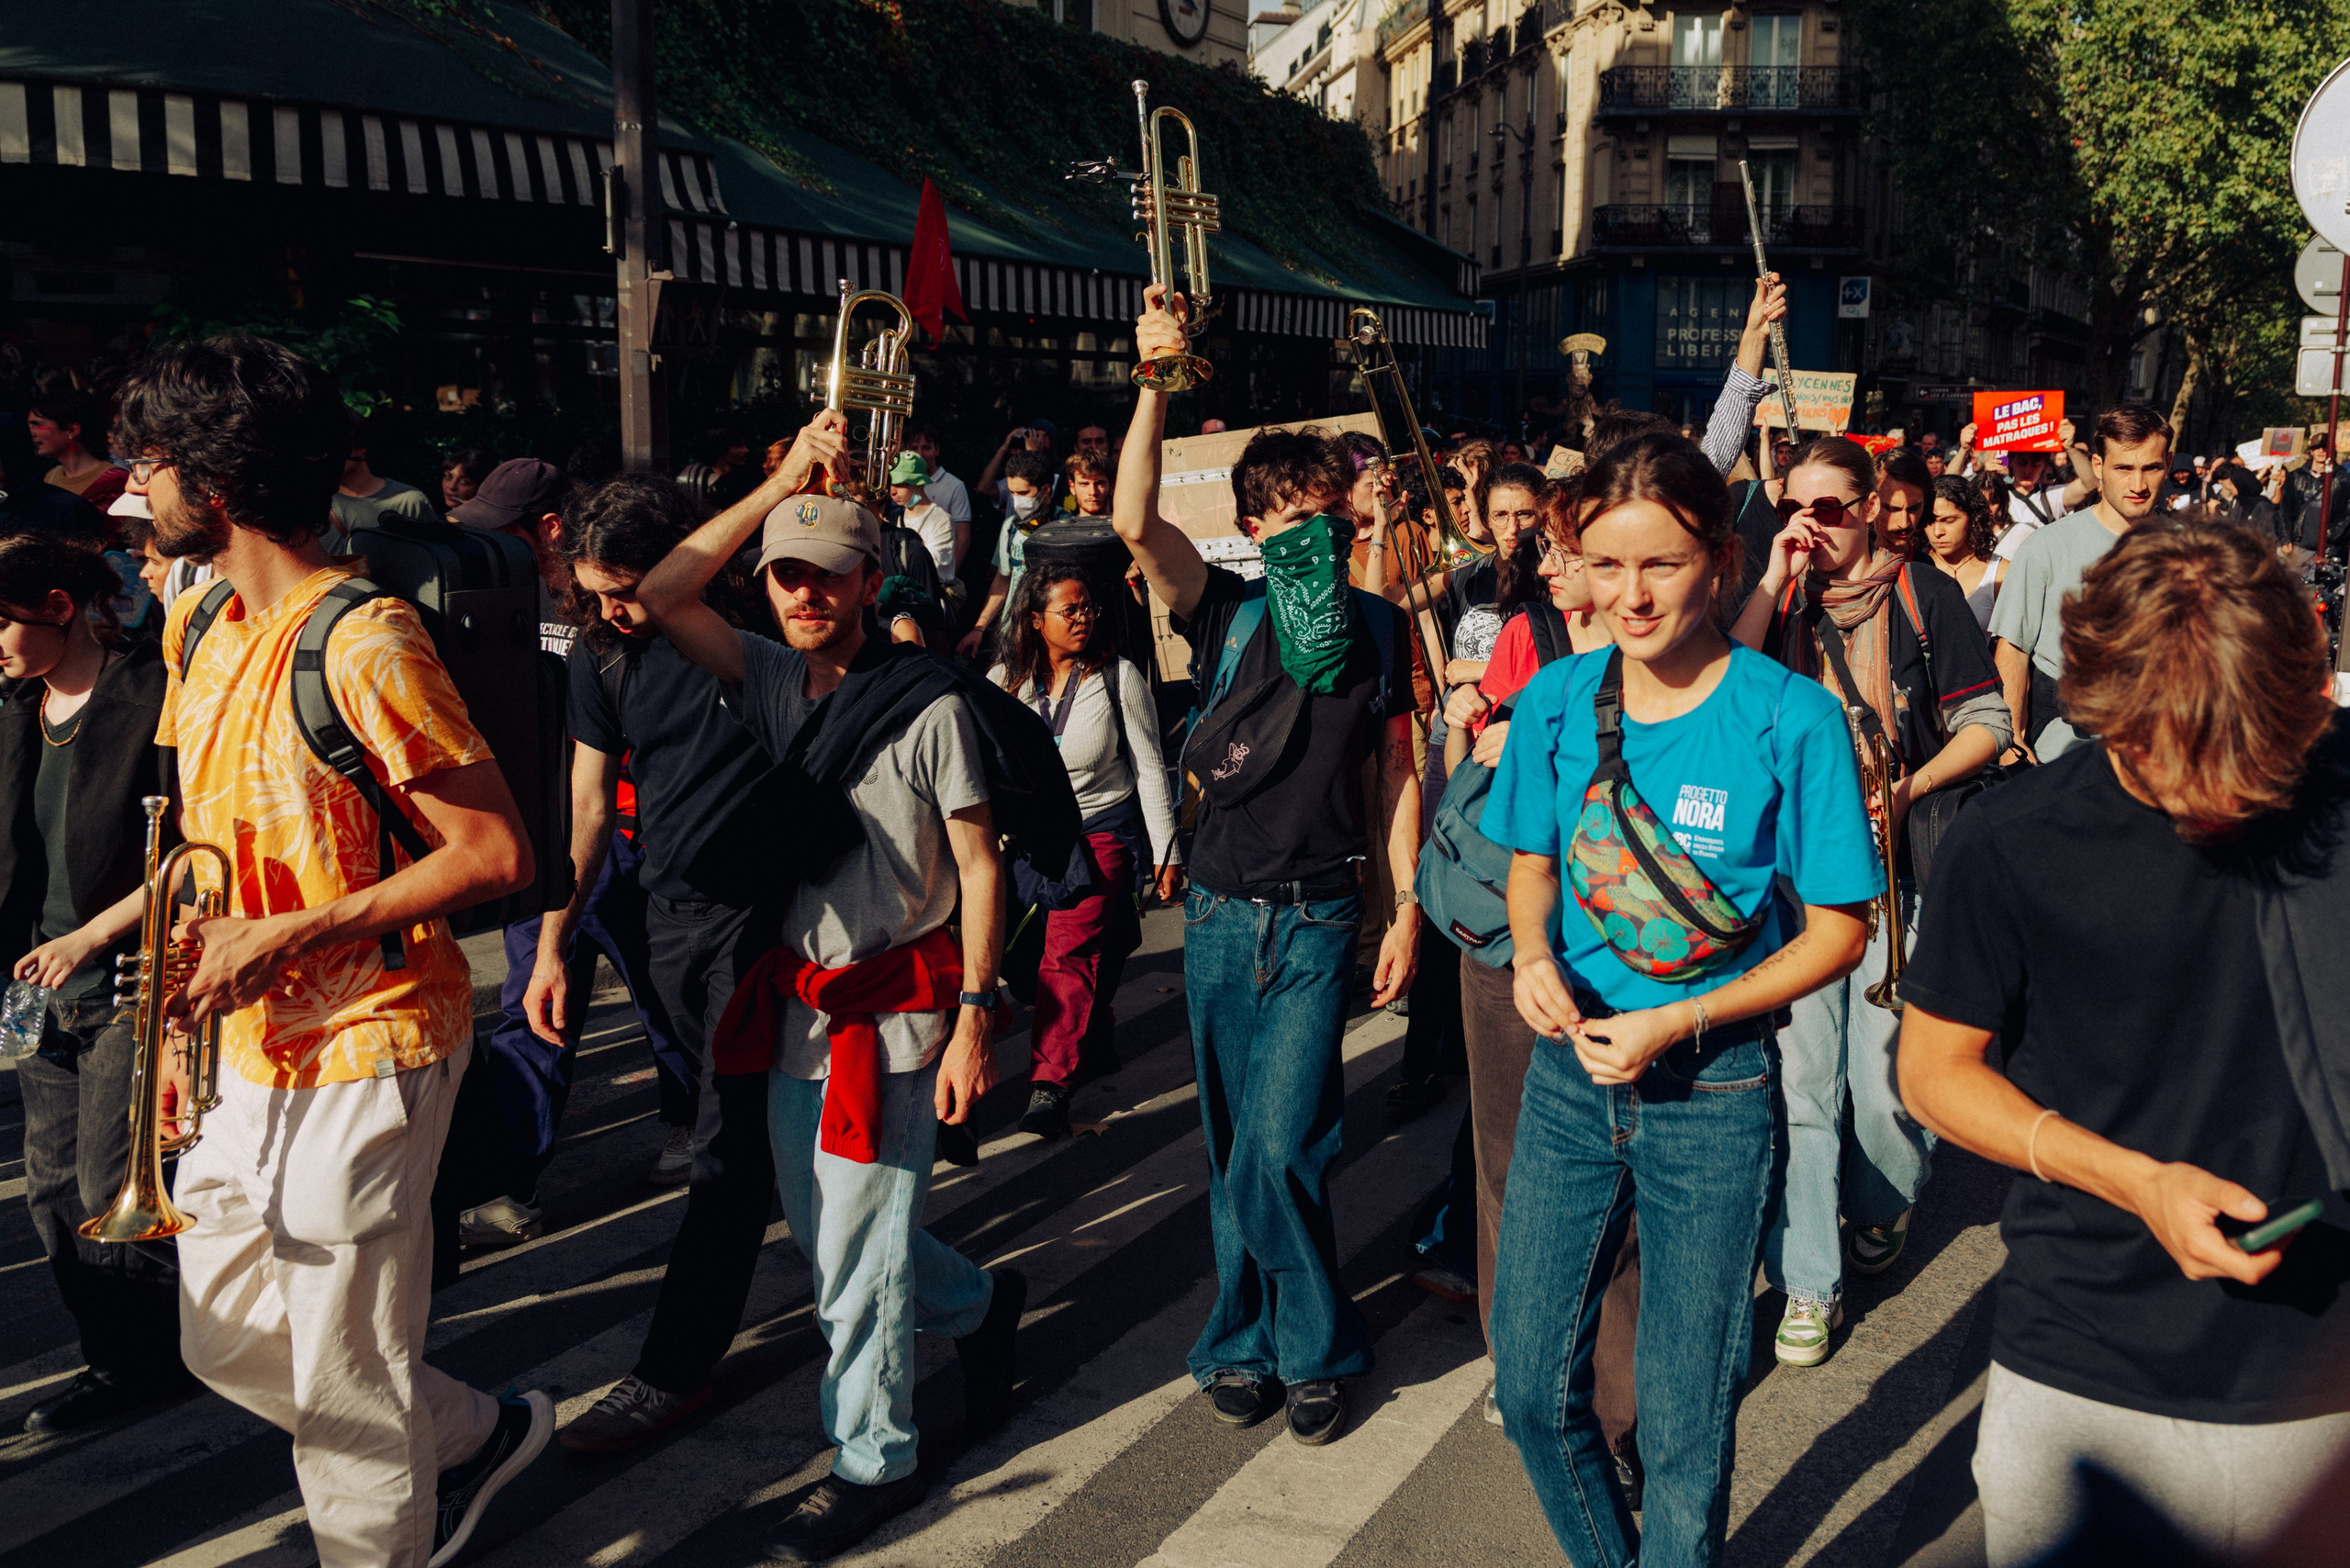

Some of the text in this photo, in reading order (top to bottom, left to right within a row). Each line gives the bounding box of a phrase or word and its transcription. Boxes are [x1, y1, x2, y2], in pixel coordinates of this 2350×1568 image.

[1669, 308, 1740, 319] AGEN
[1667, 328, 1742, 342] PROFESSI
[1994, 397, 2043, 421] LE BAC,
[1997, 412, 2041, 433] PAS LES
[1983, 424, 2048, 448] MATRAQUES
[2048, 421, 2054, 432] !
[539, 622, 570, 637] ECTACLE
[1678, 784, 1729, 805] PROGETTO
[1672, 798, 1725, 832] NORA
[1455, 926, 1483, 945] EASTPAK
